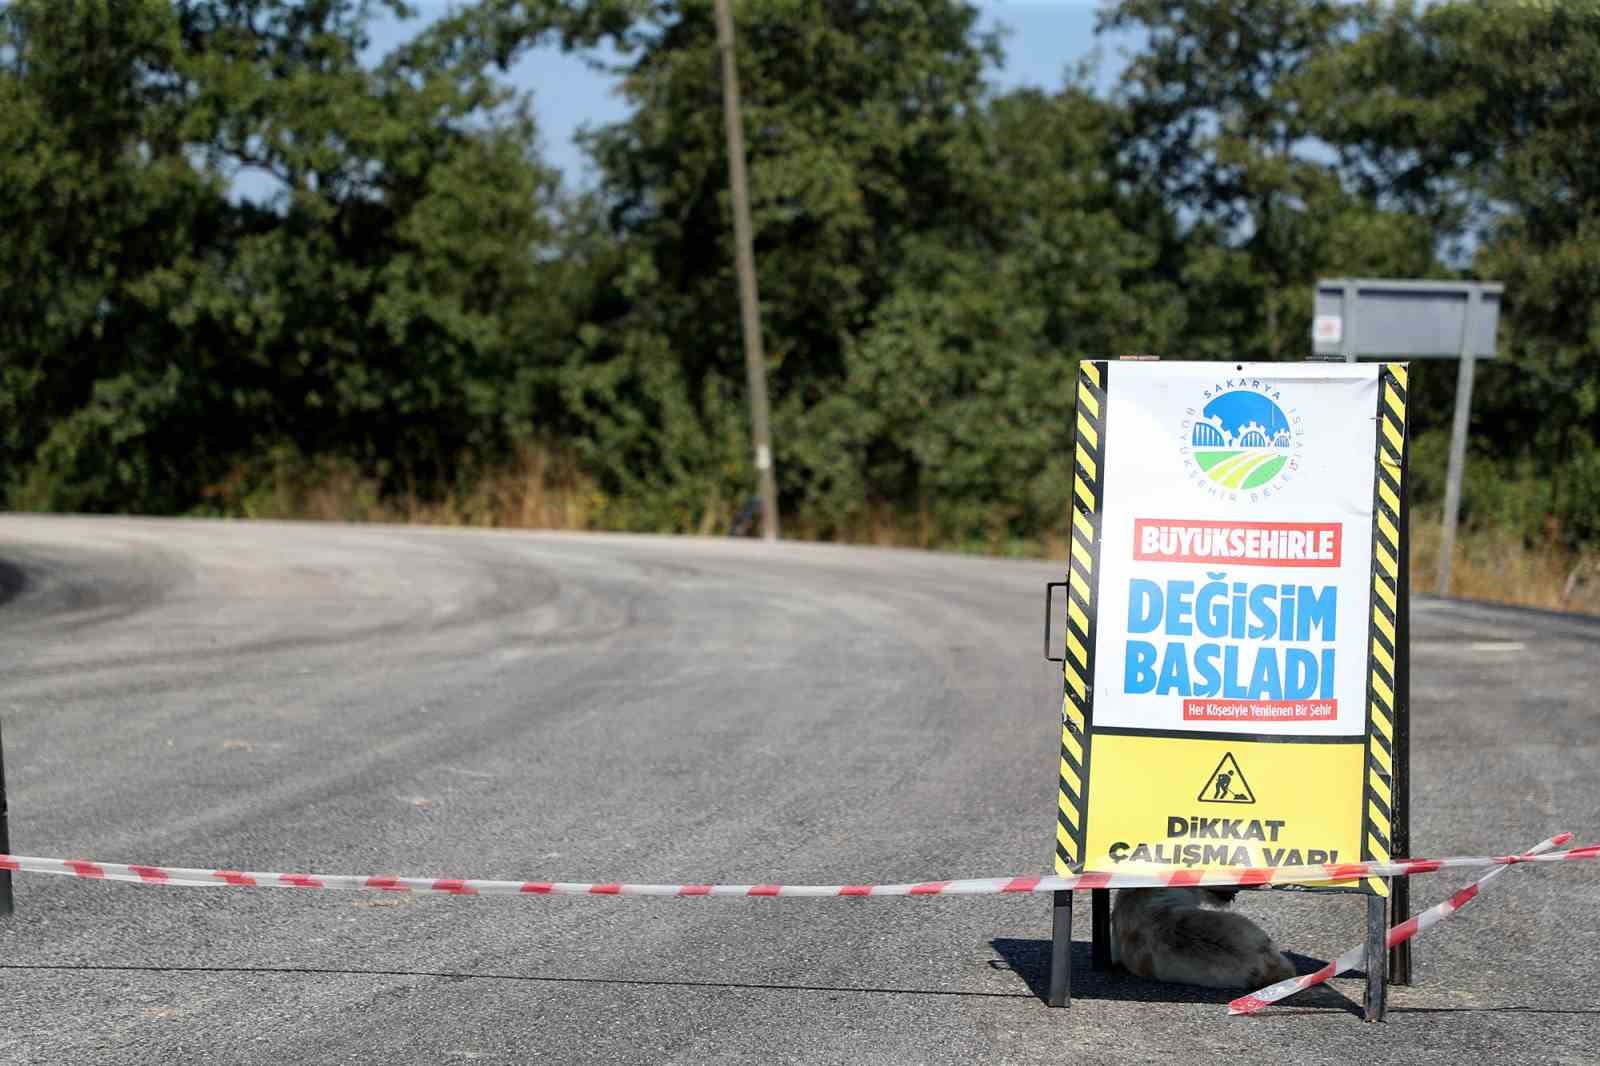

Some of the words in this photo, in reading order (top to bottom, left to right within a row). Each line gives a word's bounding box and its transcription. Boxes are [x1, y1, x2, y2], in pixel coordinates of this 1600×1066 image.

[1204, 378, 1280, 400] SAKARYA
[1127, 571, 1337, 641] DEĞİŞİM
[1124, 640, 1336, 700] BAŞLADI
[1188, 704, 1205, 717] Her
[1250, 704, 1295, 717] Yenilenen
[1295, 704, 1309, 717] Bir
[1167, 816, 1285, 842] DİKKAT
[1108, 842, 1252, 868] ÇALIŞMA
